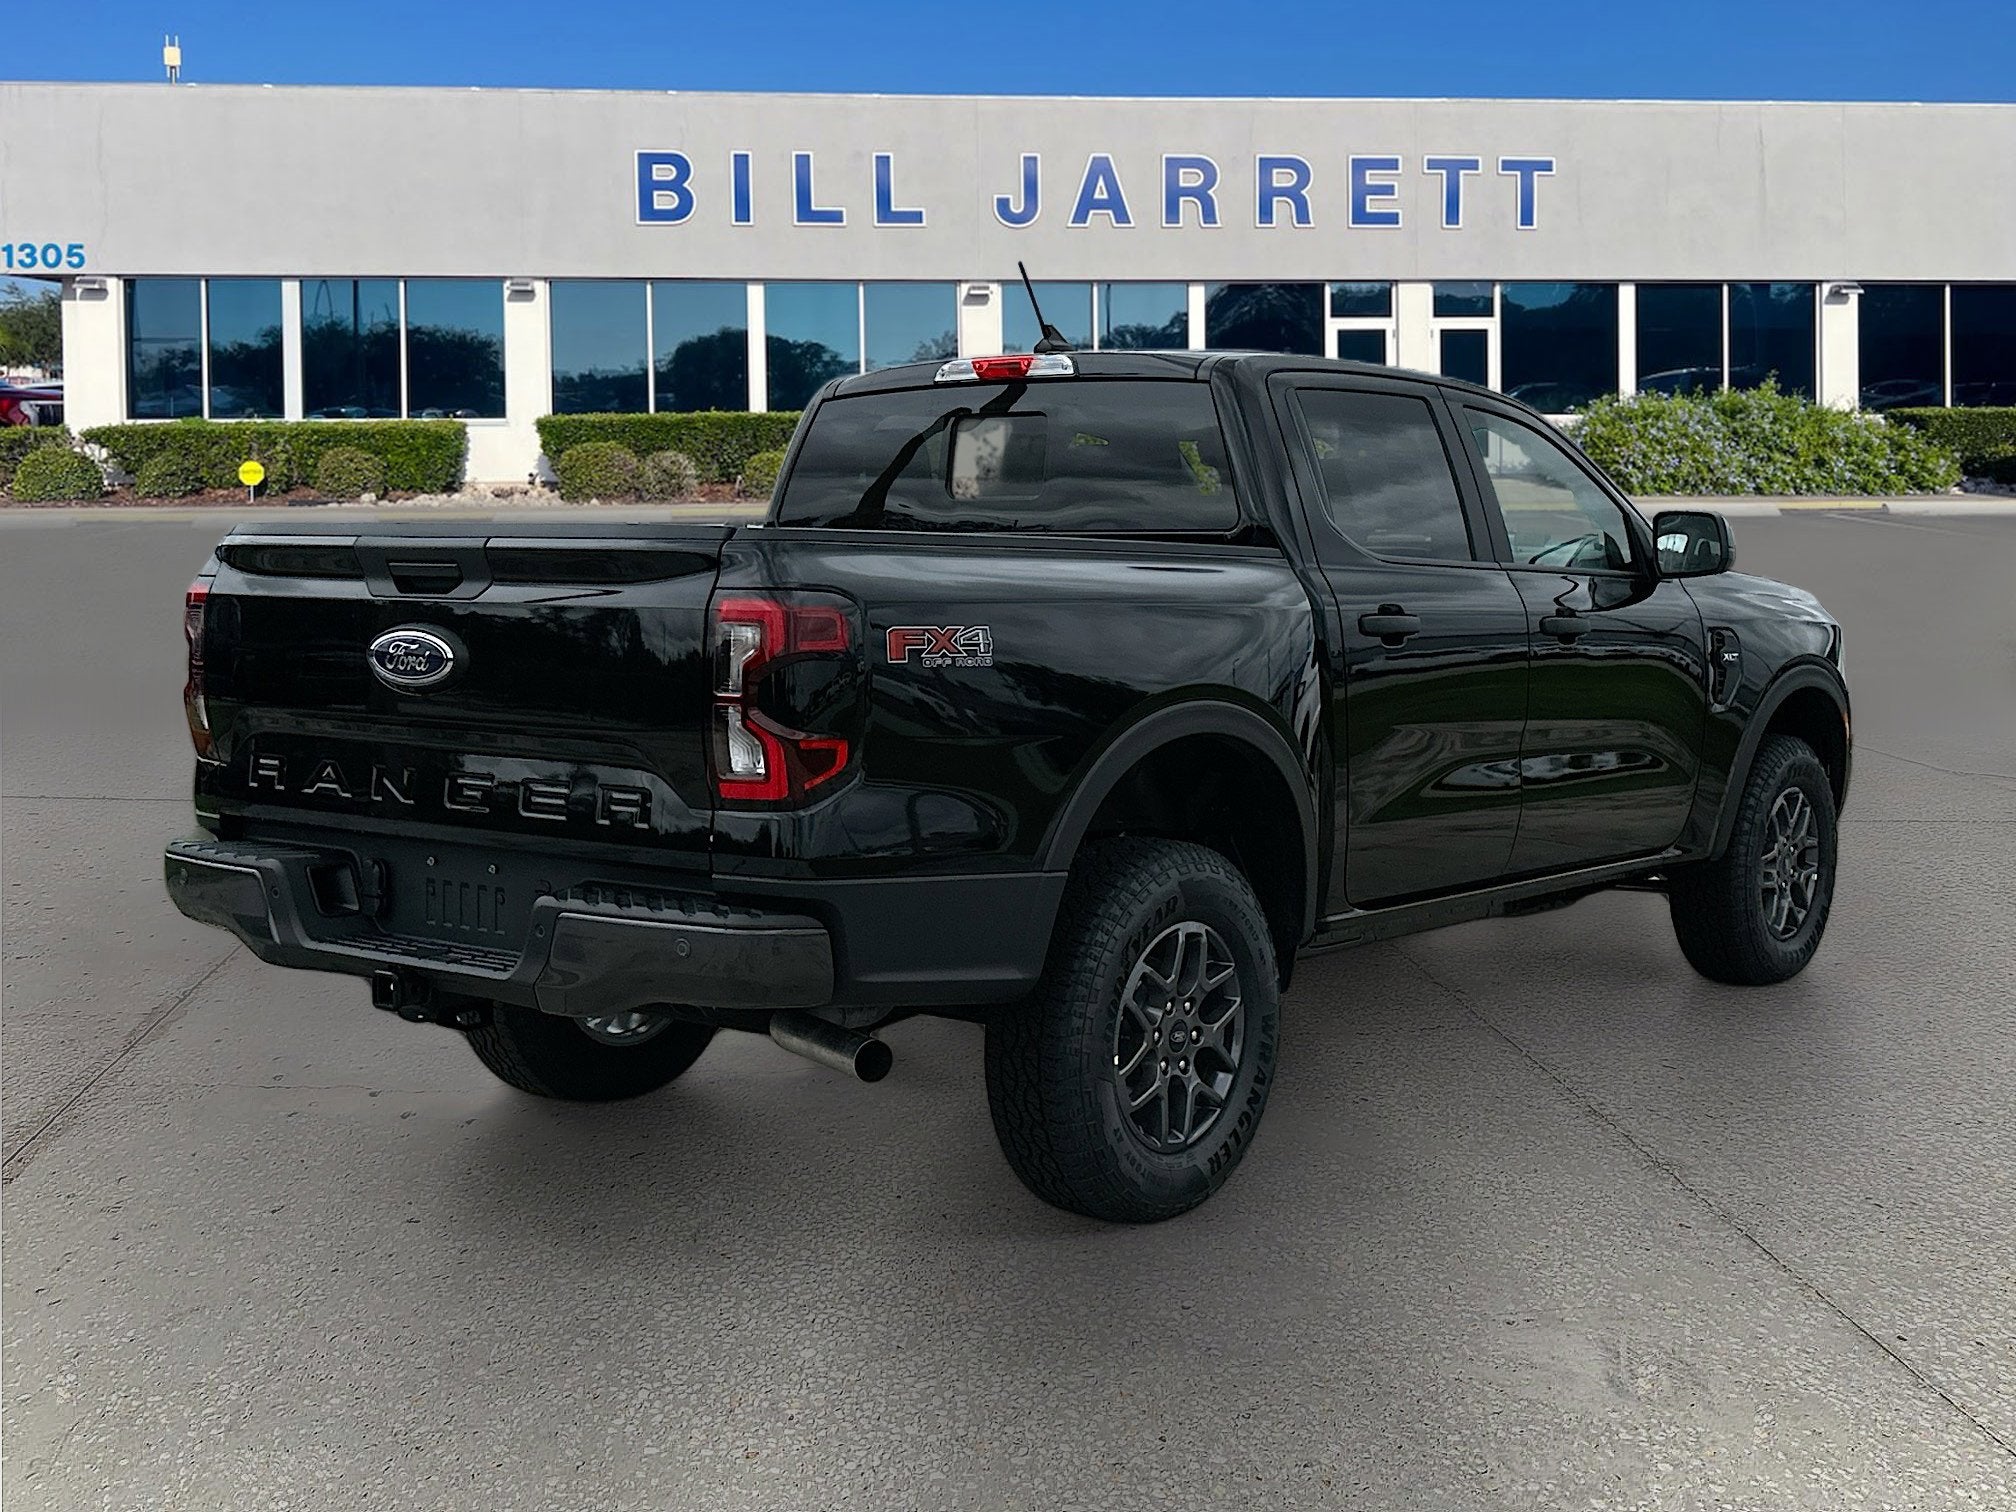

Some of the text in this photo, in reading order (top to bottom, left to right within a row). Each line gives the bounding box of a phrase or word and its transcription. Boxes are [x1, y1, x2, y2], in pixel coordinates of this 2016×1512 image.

[633, 148, 1556, 232] BILL JARRETT
[1, 243, 86, 269] 1305
[385, 641, 430, 672] Ford
[886, 625, 993, 664] FX4
[922, 656, 994, 668] OFF ROAD
[248, 752, 653, 829] RANGER
[1207, 1012, 1277, 1177] WRANGLER
